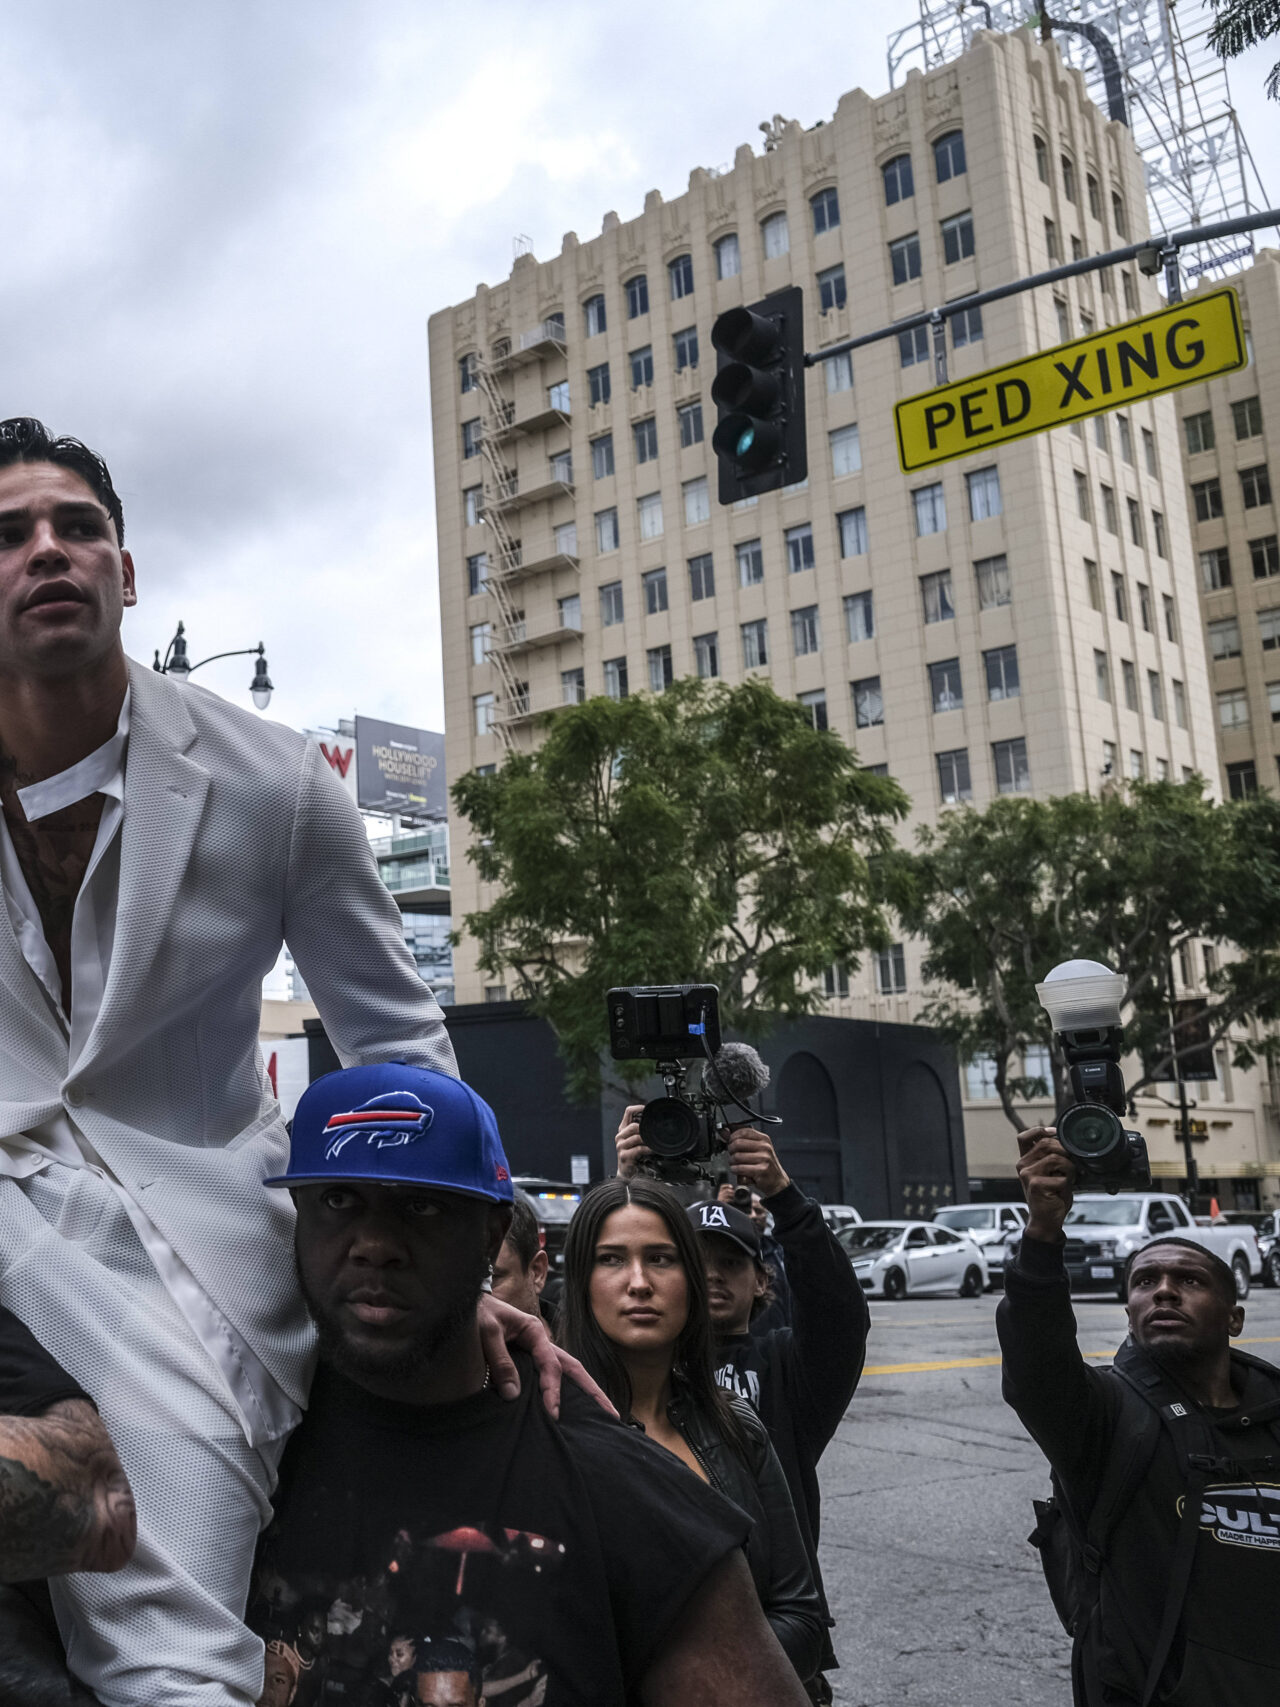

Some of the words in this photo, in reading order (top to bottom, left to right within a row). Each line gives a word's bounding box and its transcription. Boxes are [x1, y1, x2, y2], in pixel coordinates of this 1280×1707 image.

[924, 379, 1031, 450] PED
[1054, 319, 1205, 409] XING
[320, 743, 353, 778] W
[372, 745, 438, 769] HOLLYWOOD
[379, 759, 432, 780] HOUSELIFT
[699, 1205, 731, 1228] LA
[1220, 1530, 1244, 1542] MADE
[1245, 1534, 1252, 1542] IT
